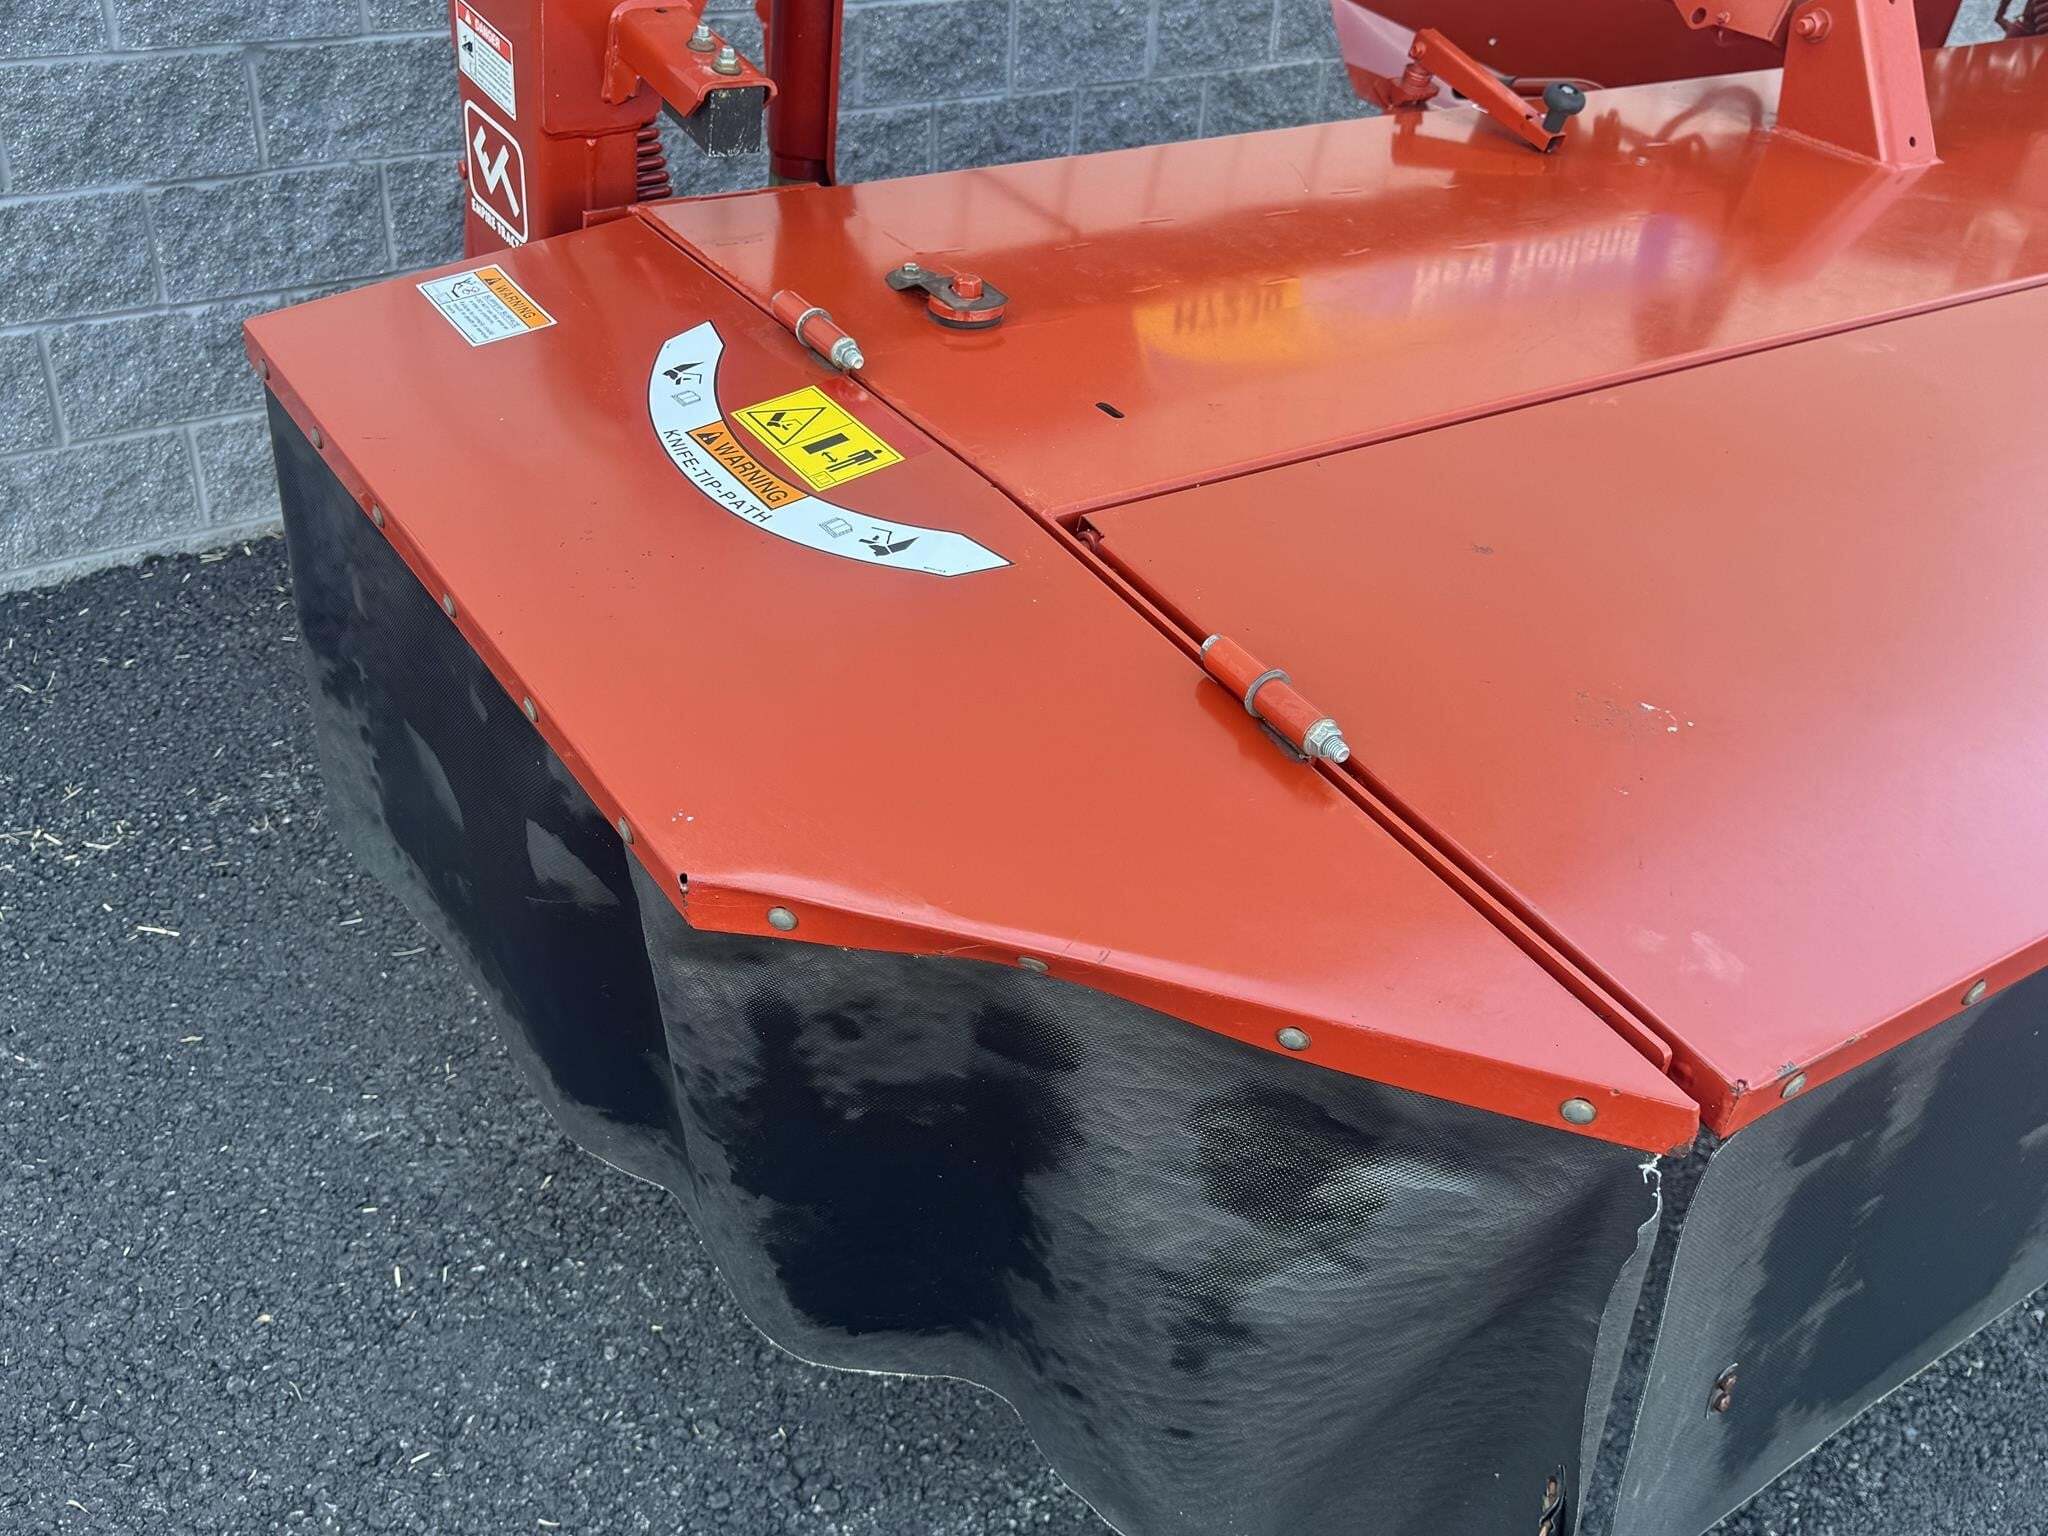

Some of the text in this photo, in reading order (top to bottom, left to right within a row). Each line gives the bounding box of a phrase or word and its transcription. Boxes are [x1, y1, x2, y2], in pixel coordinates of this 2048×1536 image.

[474, 17, 501, 51] DANGER
[471, 197, 496, 231] EMPIRE
[496, 284, 536, 320] WARNING
[663, 429, 773, 523] KNIFE-TIP-PATH
[713, 441, 788, 503] WARNING
